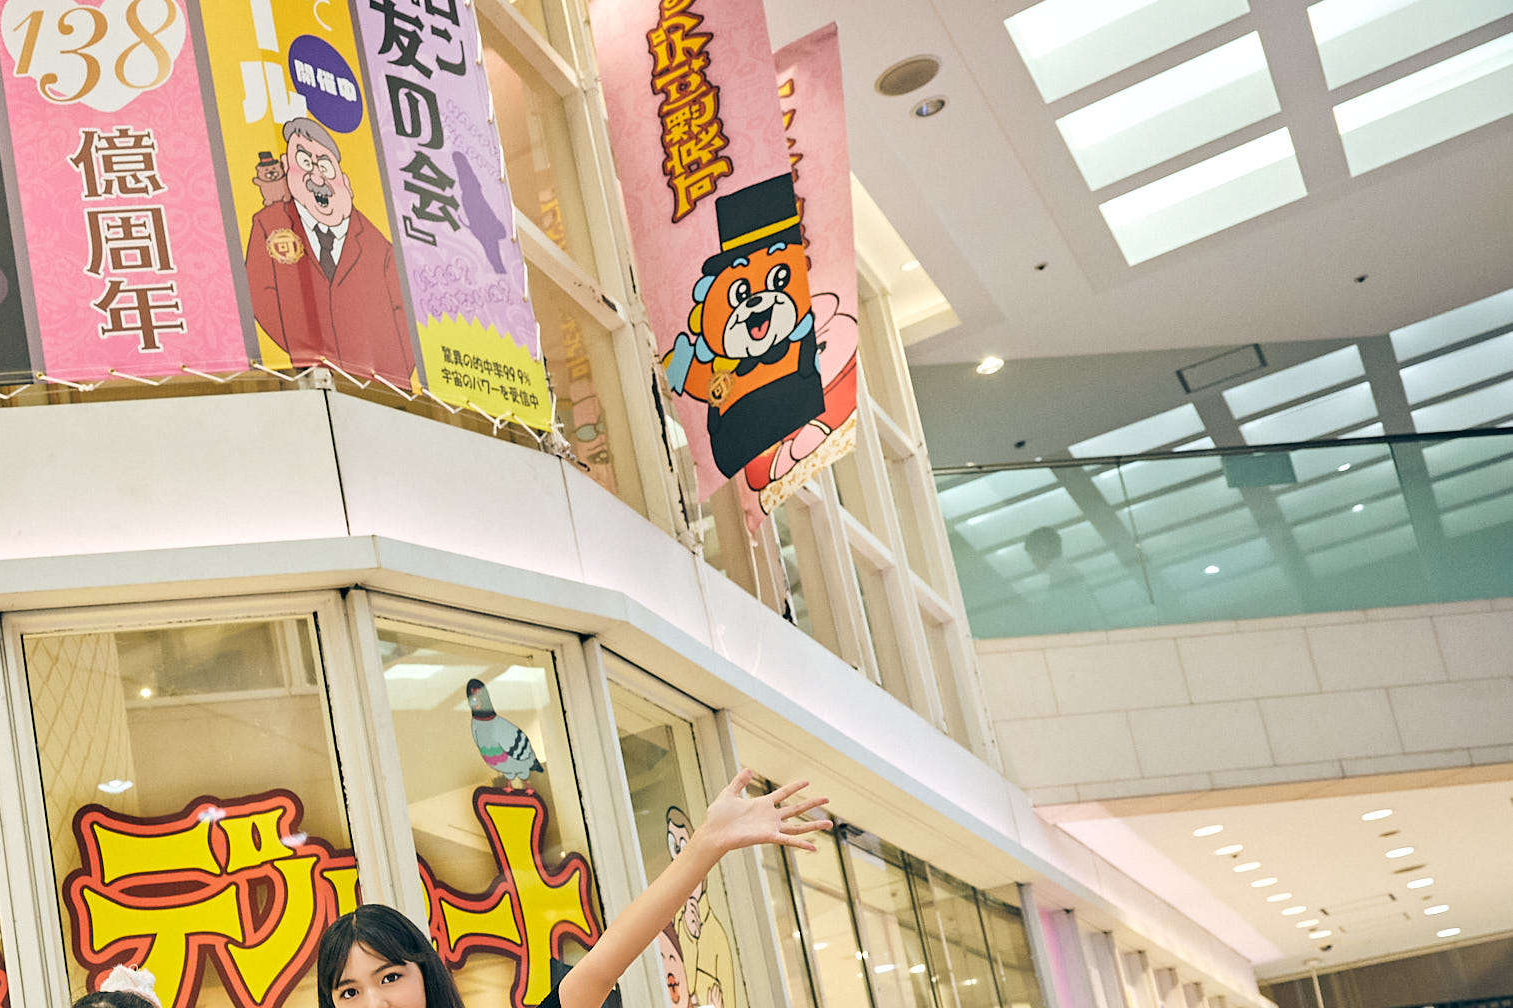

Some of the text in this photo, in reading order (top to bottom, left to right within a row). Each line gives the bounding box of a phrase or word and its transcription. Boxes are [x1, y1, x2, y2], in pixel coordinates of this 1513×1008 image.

[14, 0, 178, 102] 138
[293, 59, 357, 102] 開催中
[69, 126, 186, 353] 億周年
